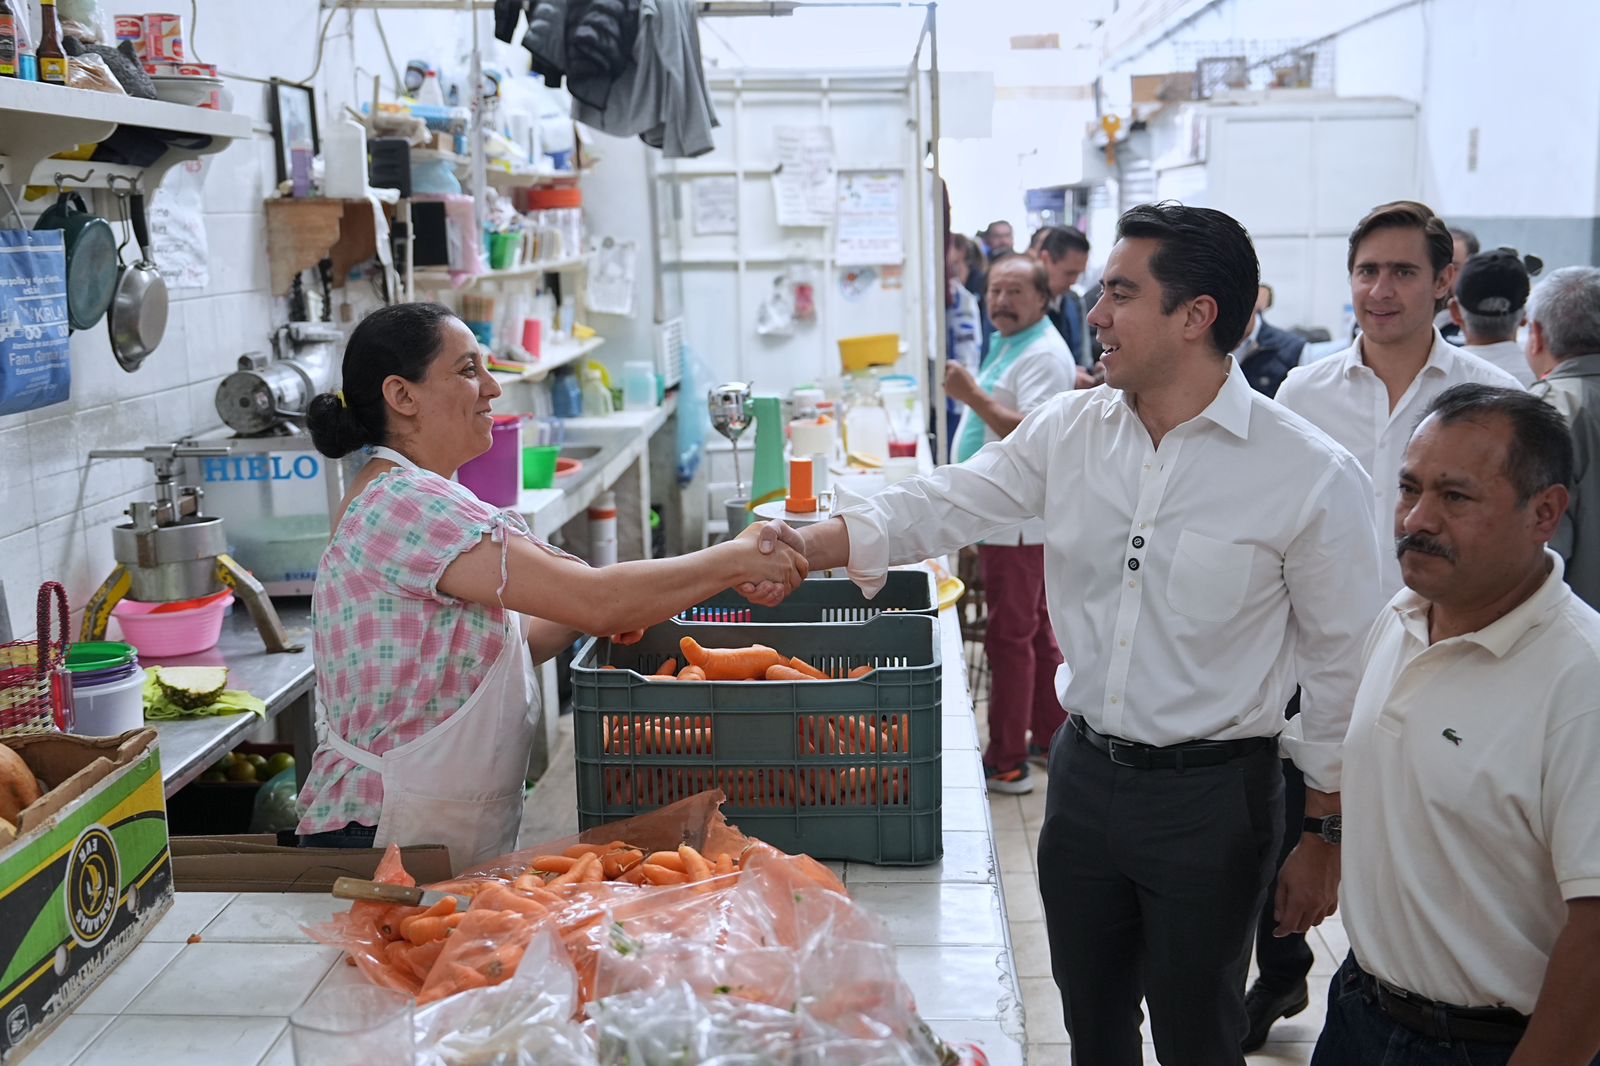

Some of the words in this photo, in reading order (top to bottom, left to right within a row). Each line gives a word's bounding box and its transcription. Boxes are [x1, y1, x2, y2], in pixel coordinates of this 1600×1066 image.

[9, 352, 33, 367] Fam.
[203, 455, 320, 482] HIELO
[78, 838, 98, 864] EVR
[76, 886, 115, 933] BANANAS
